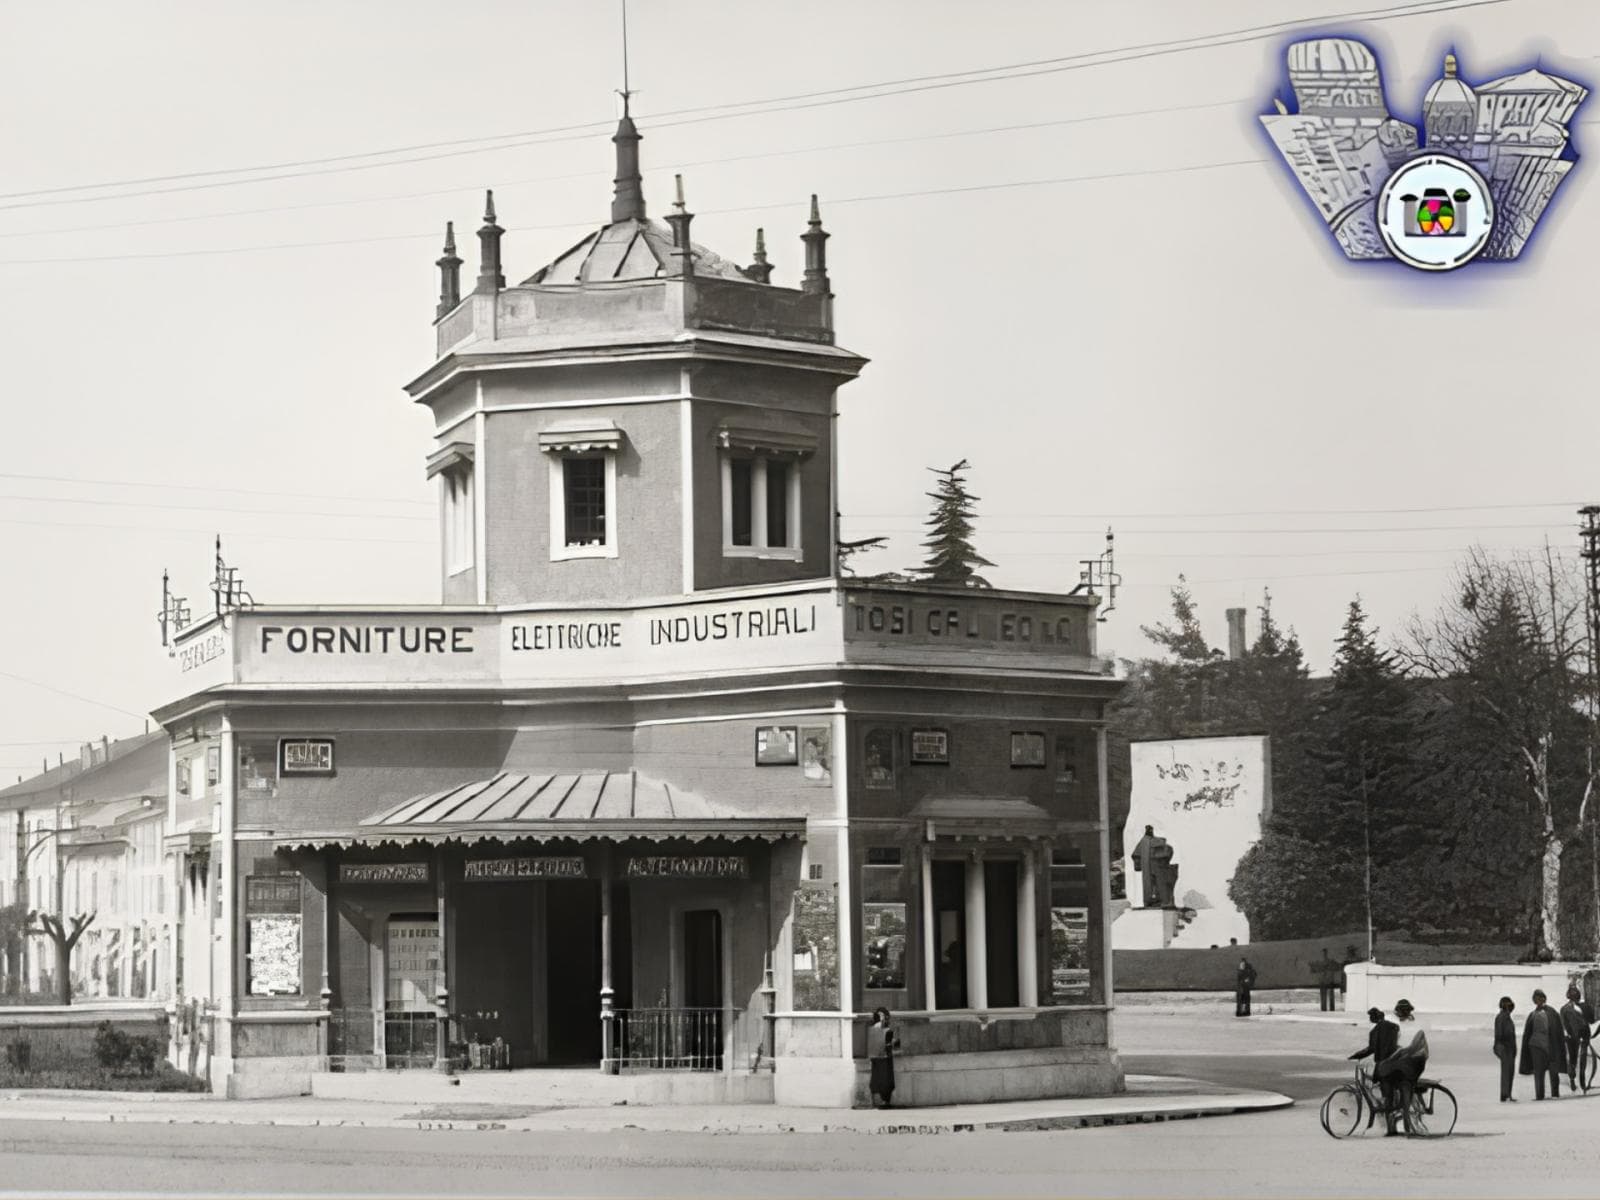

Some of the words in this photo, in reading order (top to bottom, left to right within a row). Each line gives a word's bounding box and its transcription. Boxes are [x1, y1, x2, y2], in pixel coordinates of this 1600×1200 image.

[261, 626, 474, 654] FORNITURE
[512, 623, 621, 651] ELETTRICHE
[651, 605, 815, 646] INDUSTRIALI
